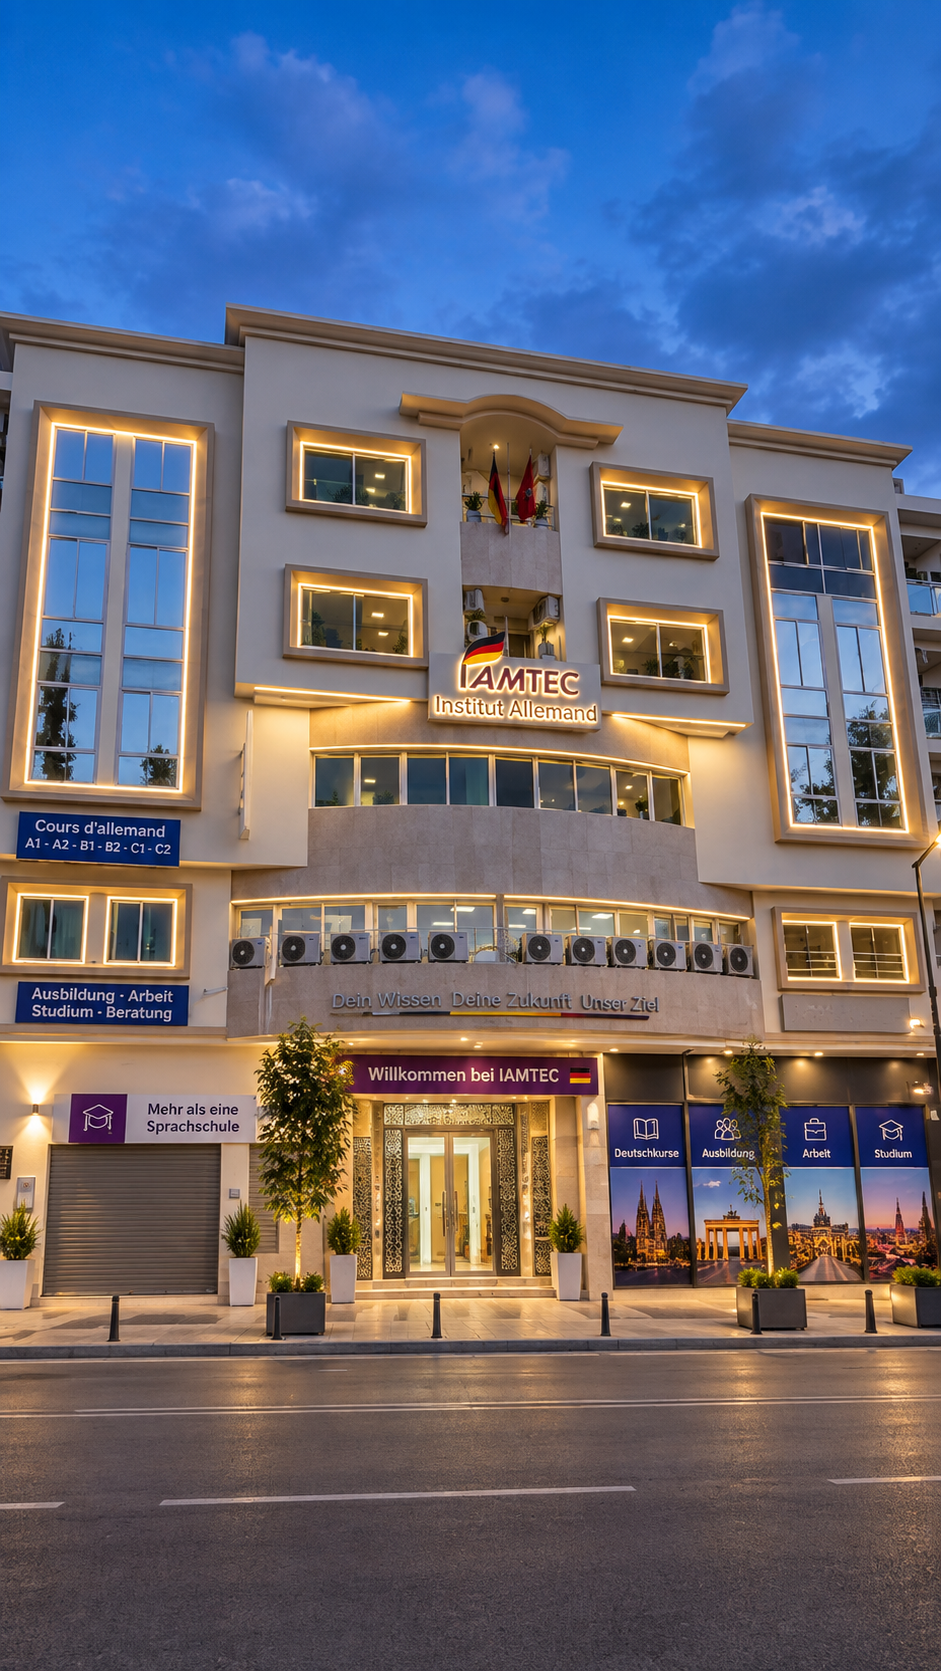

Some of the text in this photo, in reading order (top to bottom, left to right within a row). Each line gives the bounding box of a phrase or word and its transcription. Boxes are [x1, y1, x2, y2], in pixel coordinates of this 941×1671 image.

[460, 662, 579, 696] IAMTEC
[436, 695, 598, 722] Institut Allemand
[35, 819, 166, 838] Cours d'allemand
[25, 838, 41, 849] A1
[52, 839, 69, 850] A2
[80, 840, 94, 851] B1
[105, 841, 120, 852] B2
[130, 842, 145, 854] C1
[155, 844, 171, 855] C2
[31, 987, 115, 1004] Ausbildung
[128, 990, 174, 1003] Arbeit
[332, 992, 659, 1013] Dein Wissen Deine Zukunft Unser Ziel
[32, 1004, 94, 1018] Studium
[106, 1006, 172, 1022] Beratung
[368, 1066, 560, 1083] Willkommen bei IAMTEC
[147, 1102, 239, 1116] Mehr als eine
[147, 1120, 240, 1135] Sprachschule
[614, 1148, 680, 1159] Deutschkurse
[702, 1148, 755, 1160] Ausbildung
[802, 1148, 831, 1158] Arbeit
[874, 1149, 912, 1159] Studium
